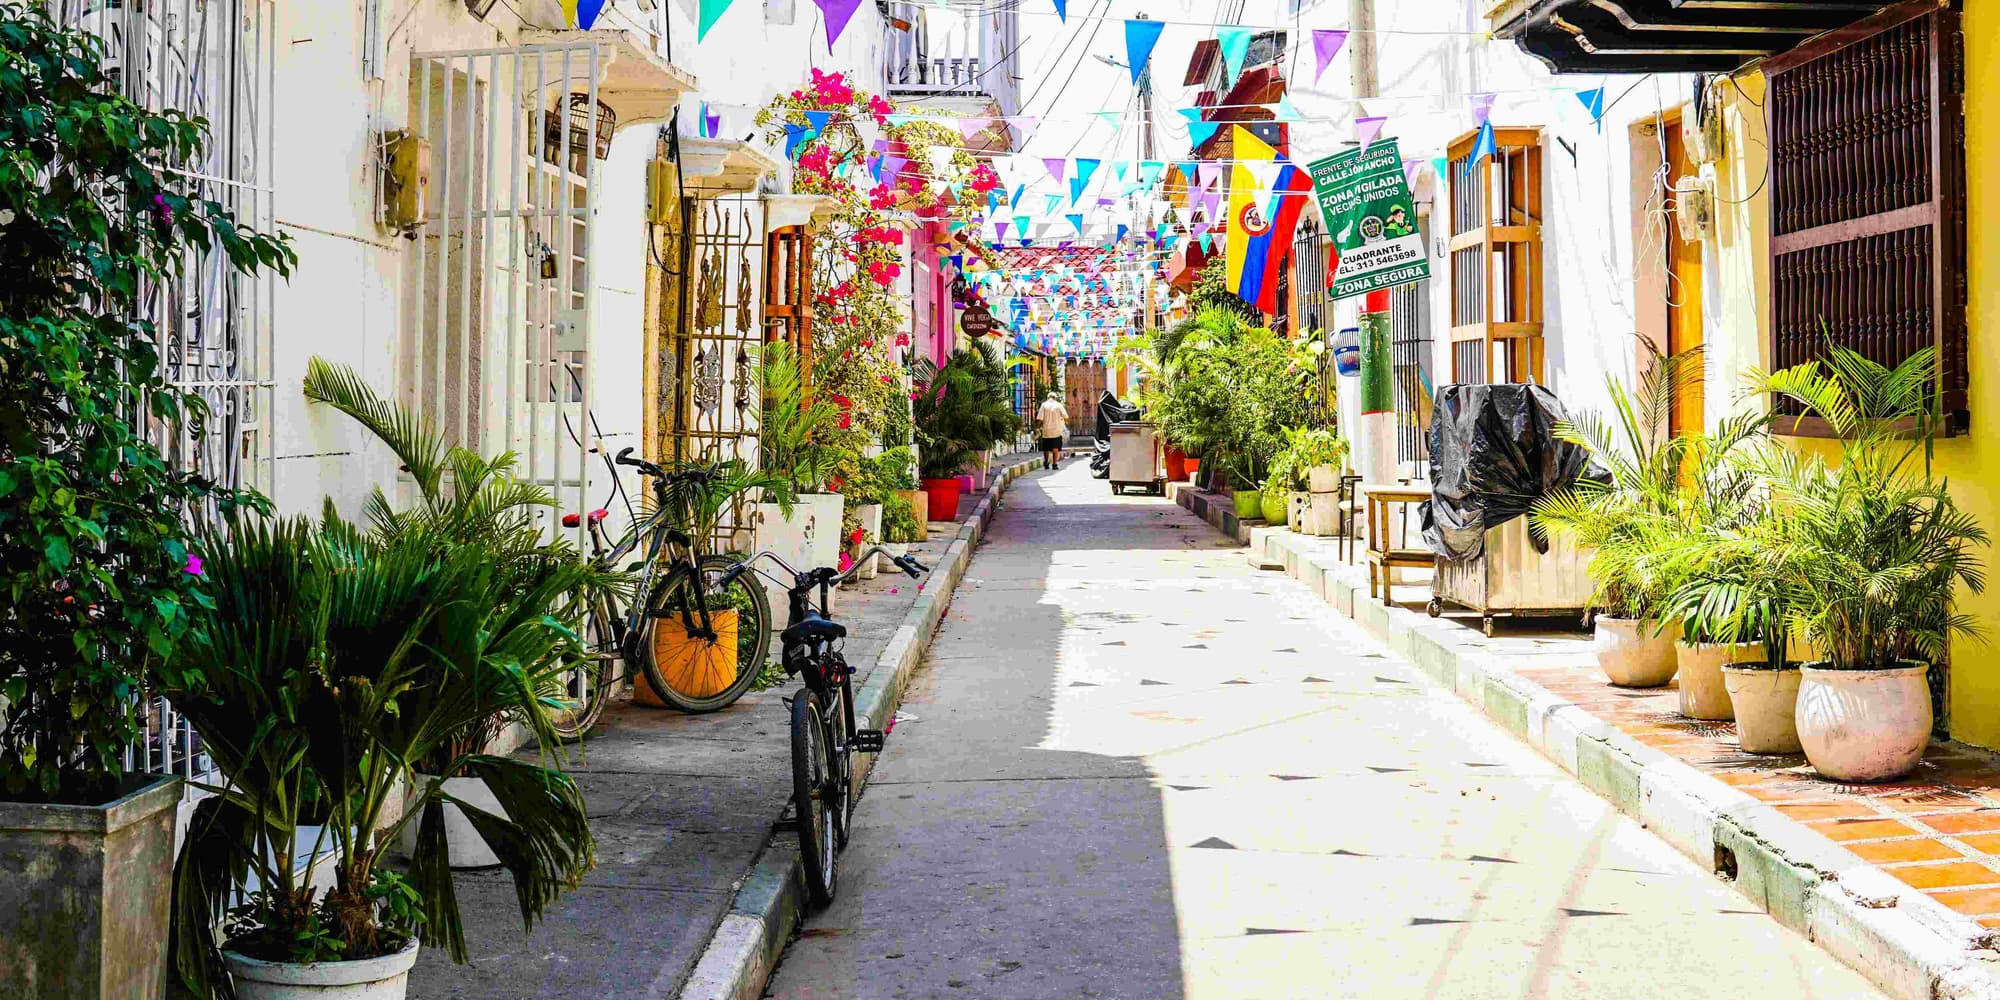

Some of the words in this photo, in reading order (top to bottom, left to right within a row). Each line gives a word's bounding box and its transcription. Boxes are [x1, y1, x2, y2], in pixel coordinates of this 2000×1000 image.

[1313, 162, 1341, 177] FRENTE
[1343, 158, 1354, 168] DE
[1355, 147, 1395, 163] SEGURIDAD
[1364, 156, 1395, 171] ANCHO
[1321, 189, 1354, 207] ZONA
[1363, 186, 1399, 203] UNIDOS
[1339, 265, 1355, 275] EL:
[1356, 260, 1374, 270] 313
[1376, 249, 1417, 266] 5463698
[1342, 244, 1402, 264] CUADRANTE
[1336, 279, 1373, 296] ZONA
[1374, 266, 1424, 285] SEGURA
[964, 313, 975, 321] VIVE
